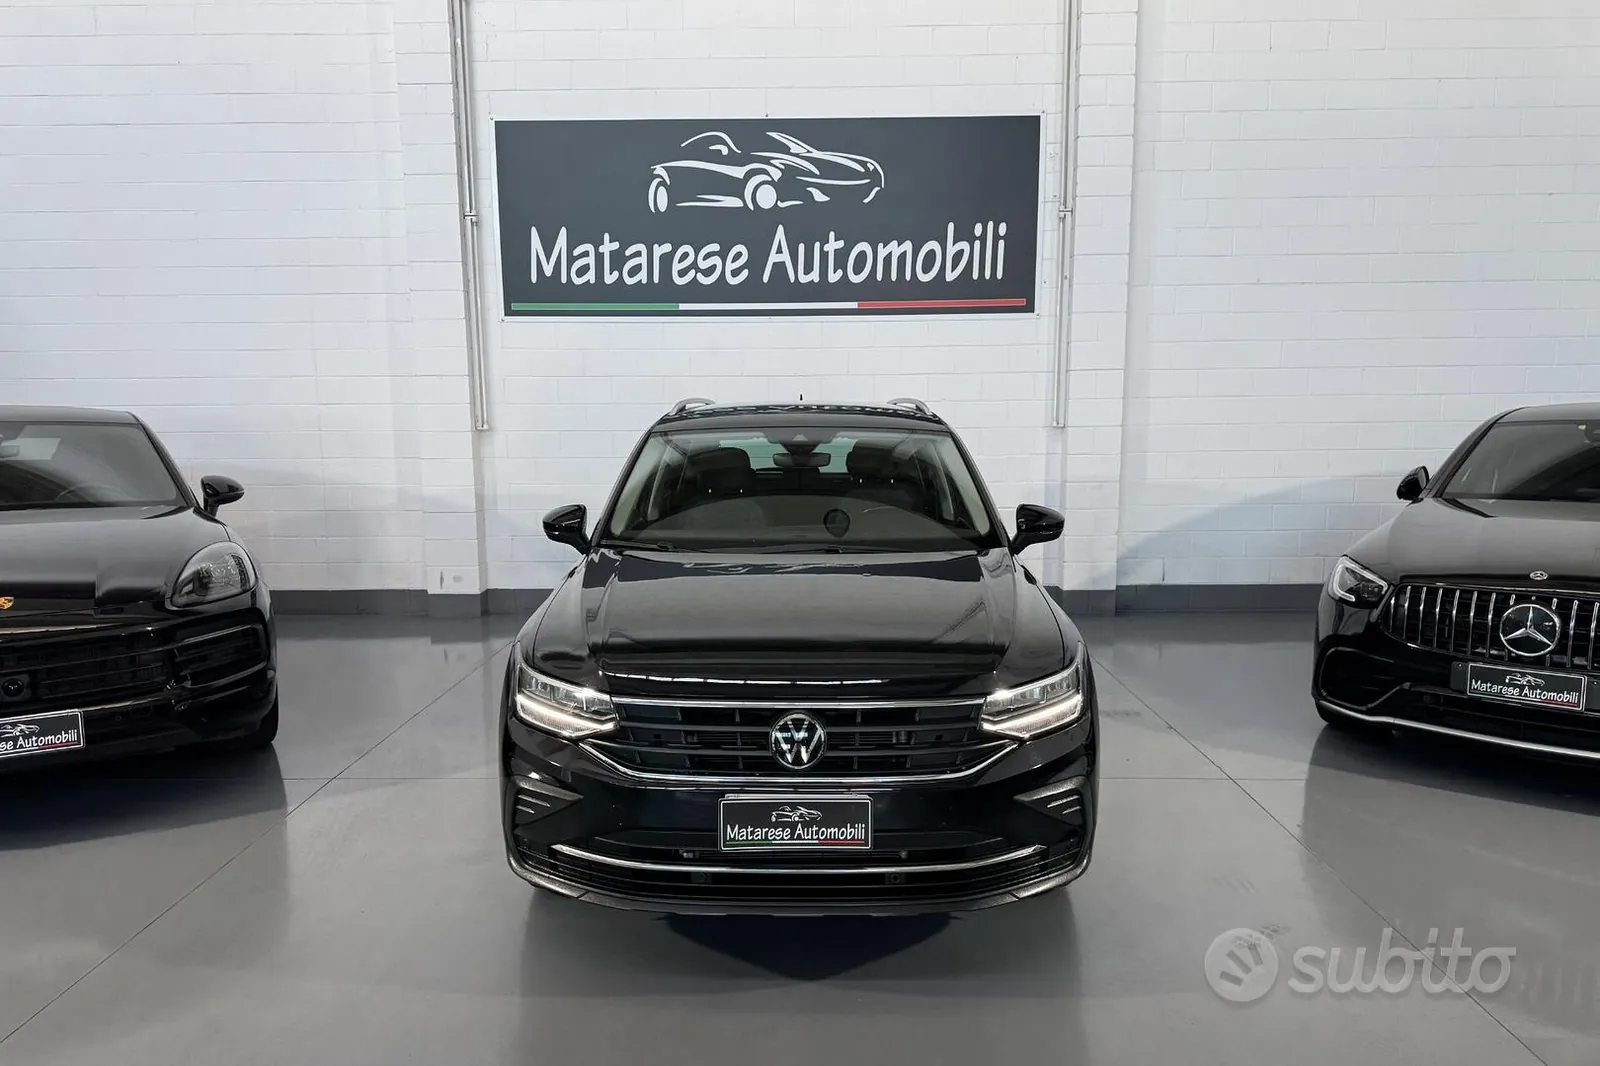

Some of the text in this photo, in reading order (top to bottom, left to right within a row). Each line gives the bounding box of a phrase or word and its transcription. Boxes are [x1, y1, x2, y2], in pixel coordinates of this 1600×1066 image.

[530, 221, 1008, 286] Matarese Automobili
[1471, 679, 1579, 704] Matarese Automobili
[16, 729, 78, 748] Automobili
[726, 823, 865, 840] Matarese Automobili
